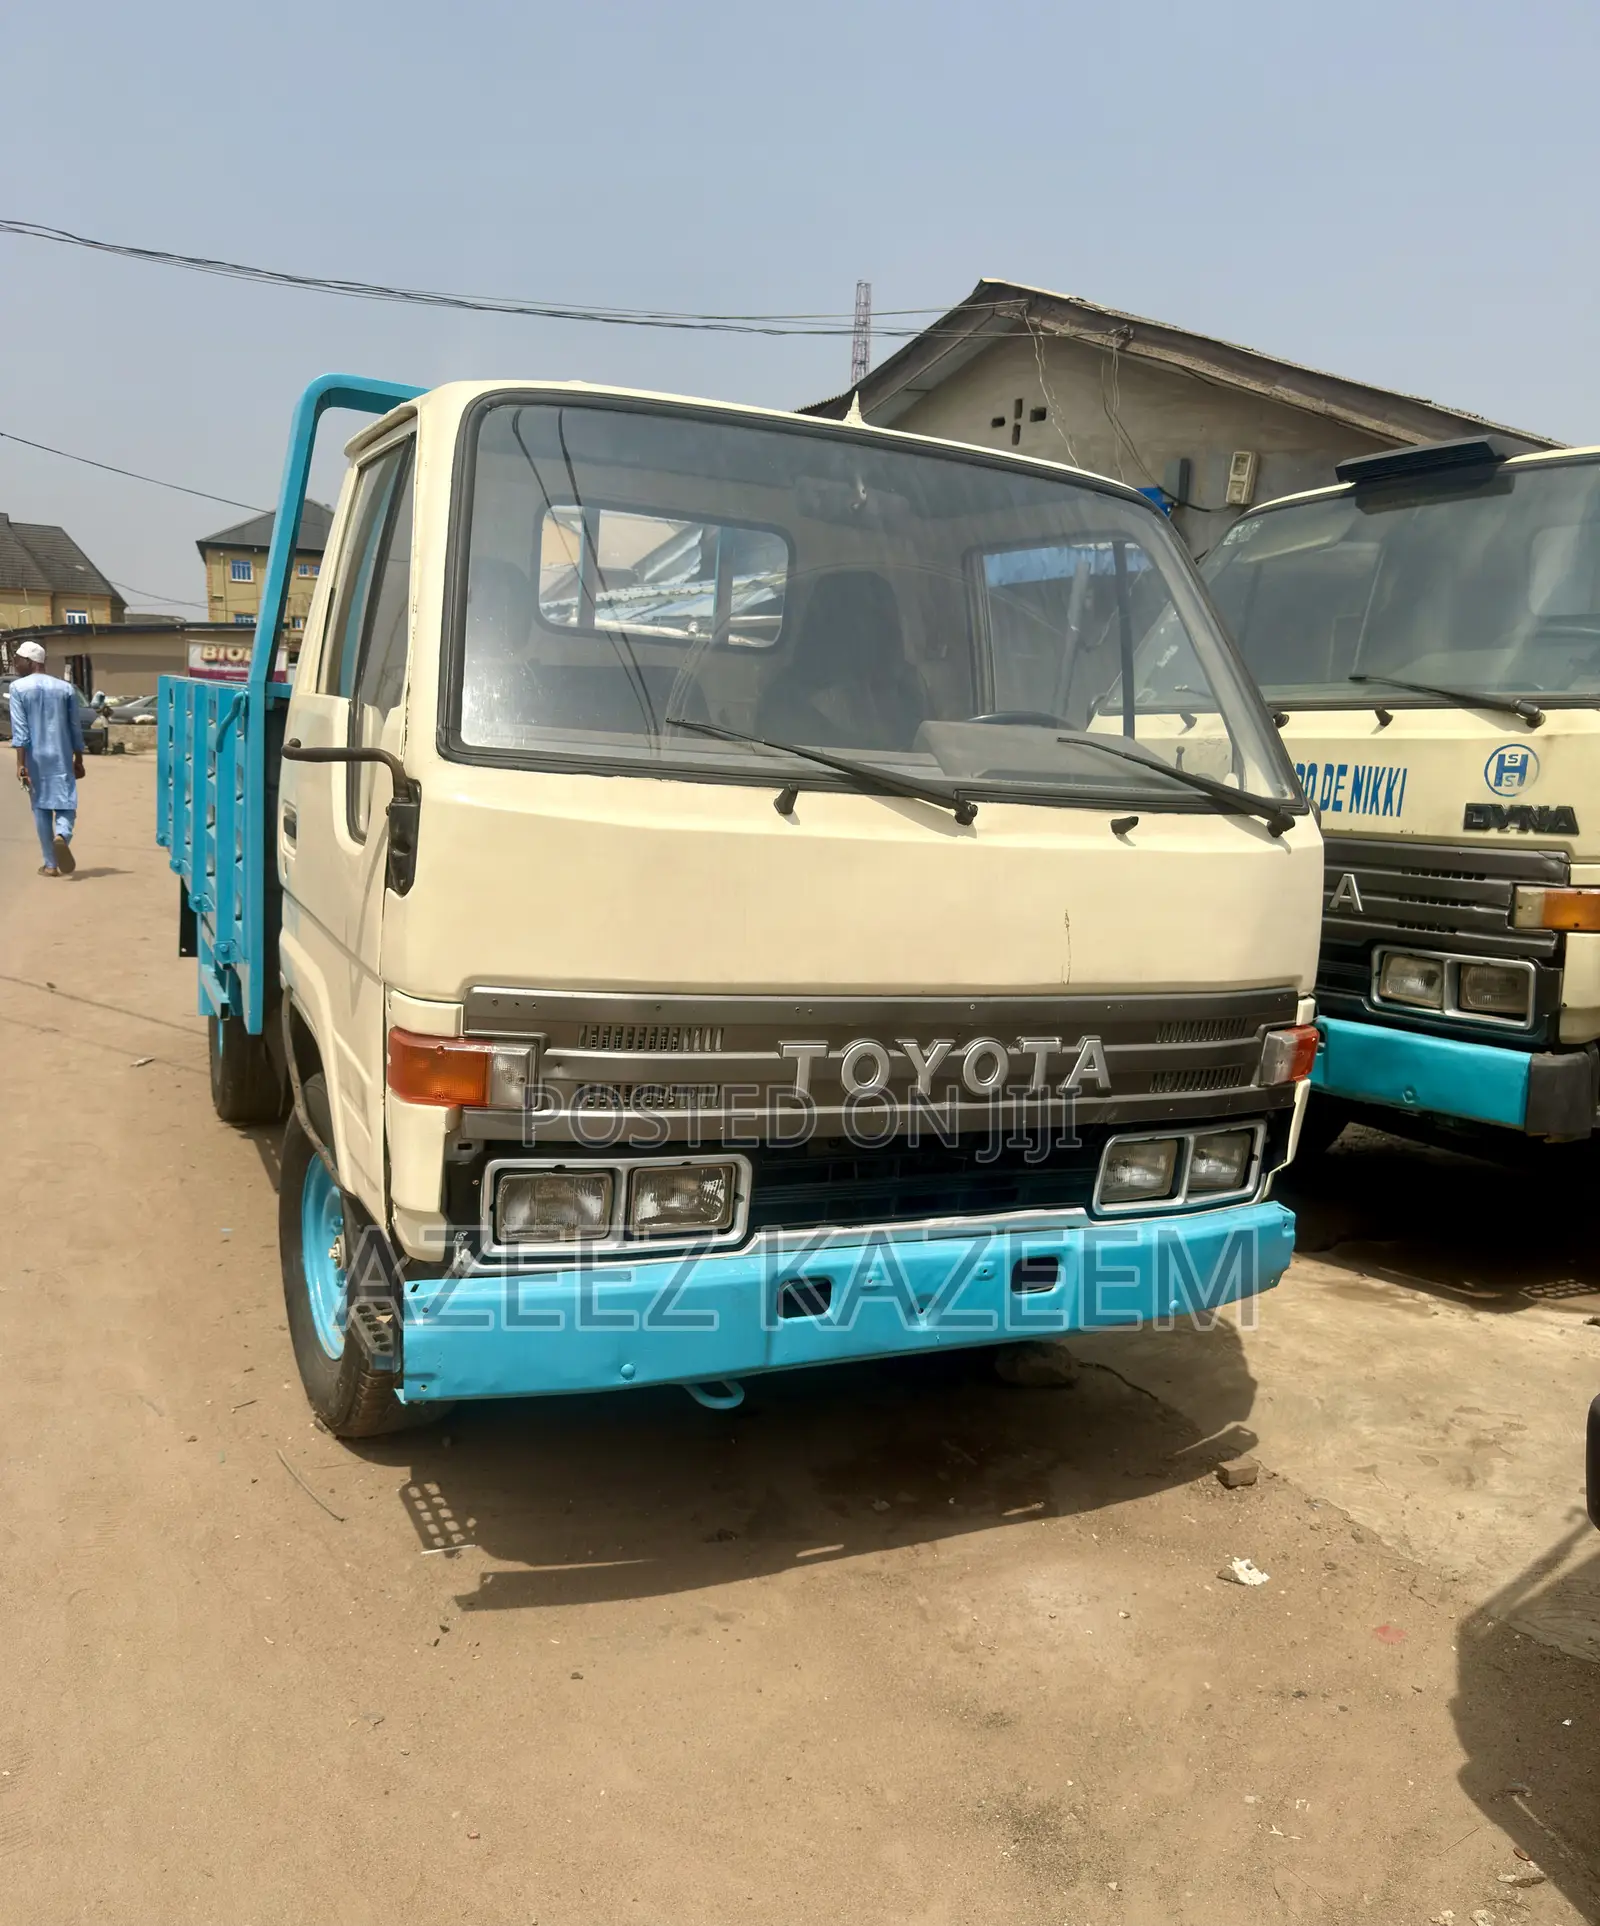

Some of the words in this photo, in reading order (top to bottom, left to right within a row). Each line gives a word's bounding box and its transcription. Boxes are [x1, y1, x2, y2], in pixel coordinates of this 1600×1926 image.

[1319, 763, 1348, 812] DE
[1348, 764, 1408, 818] NIKKI
[1463, 803, 1580, 836] DYNA
[777, 1034, 1112, 1097] TOYOTA
